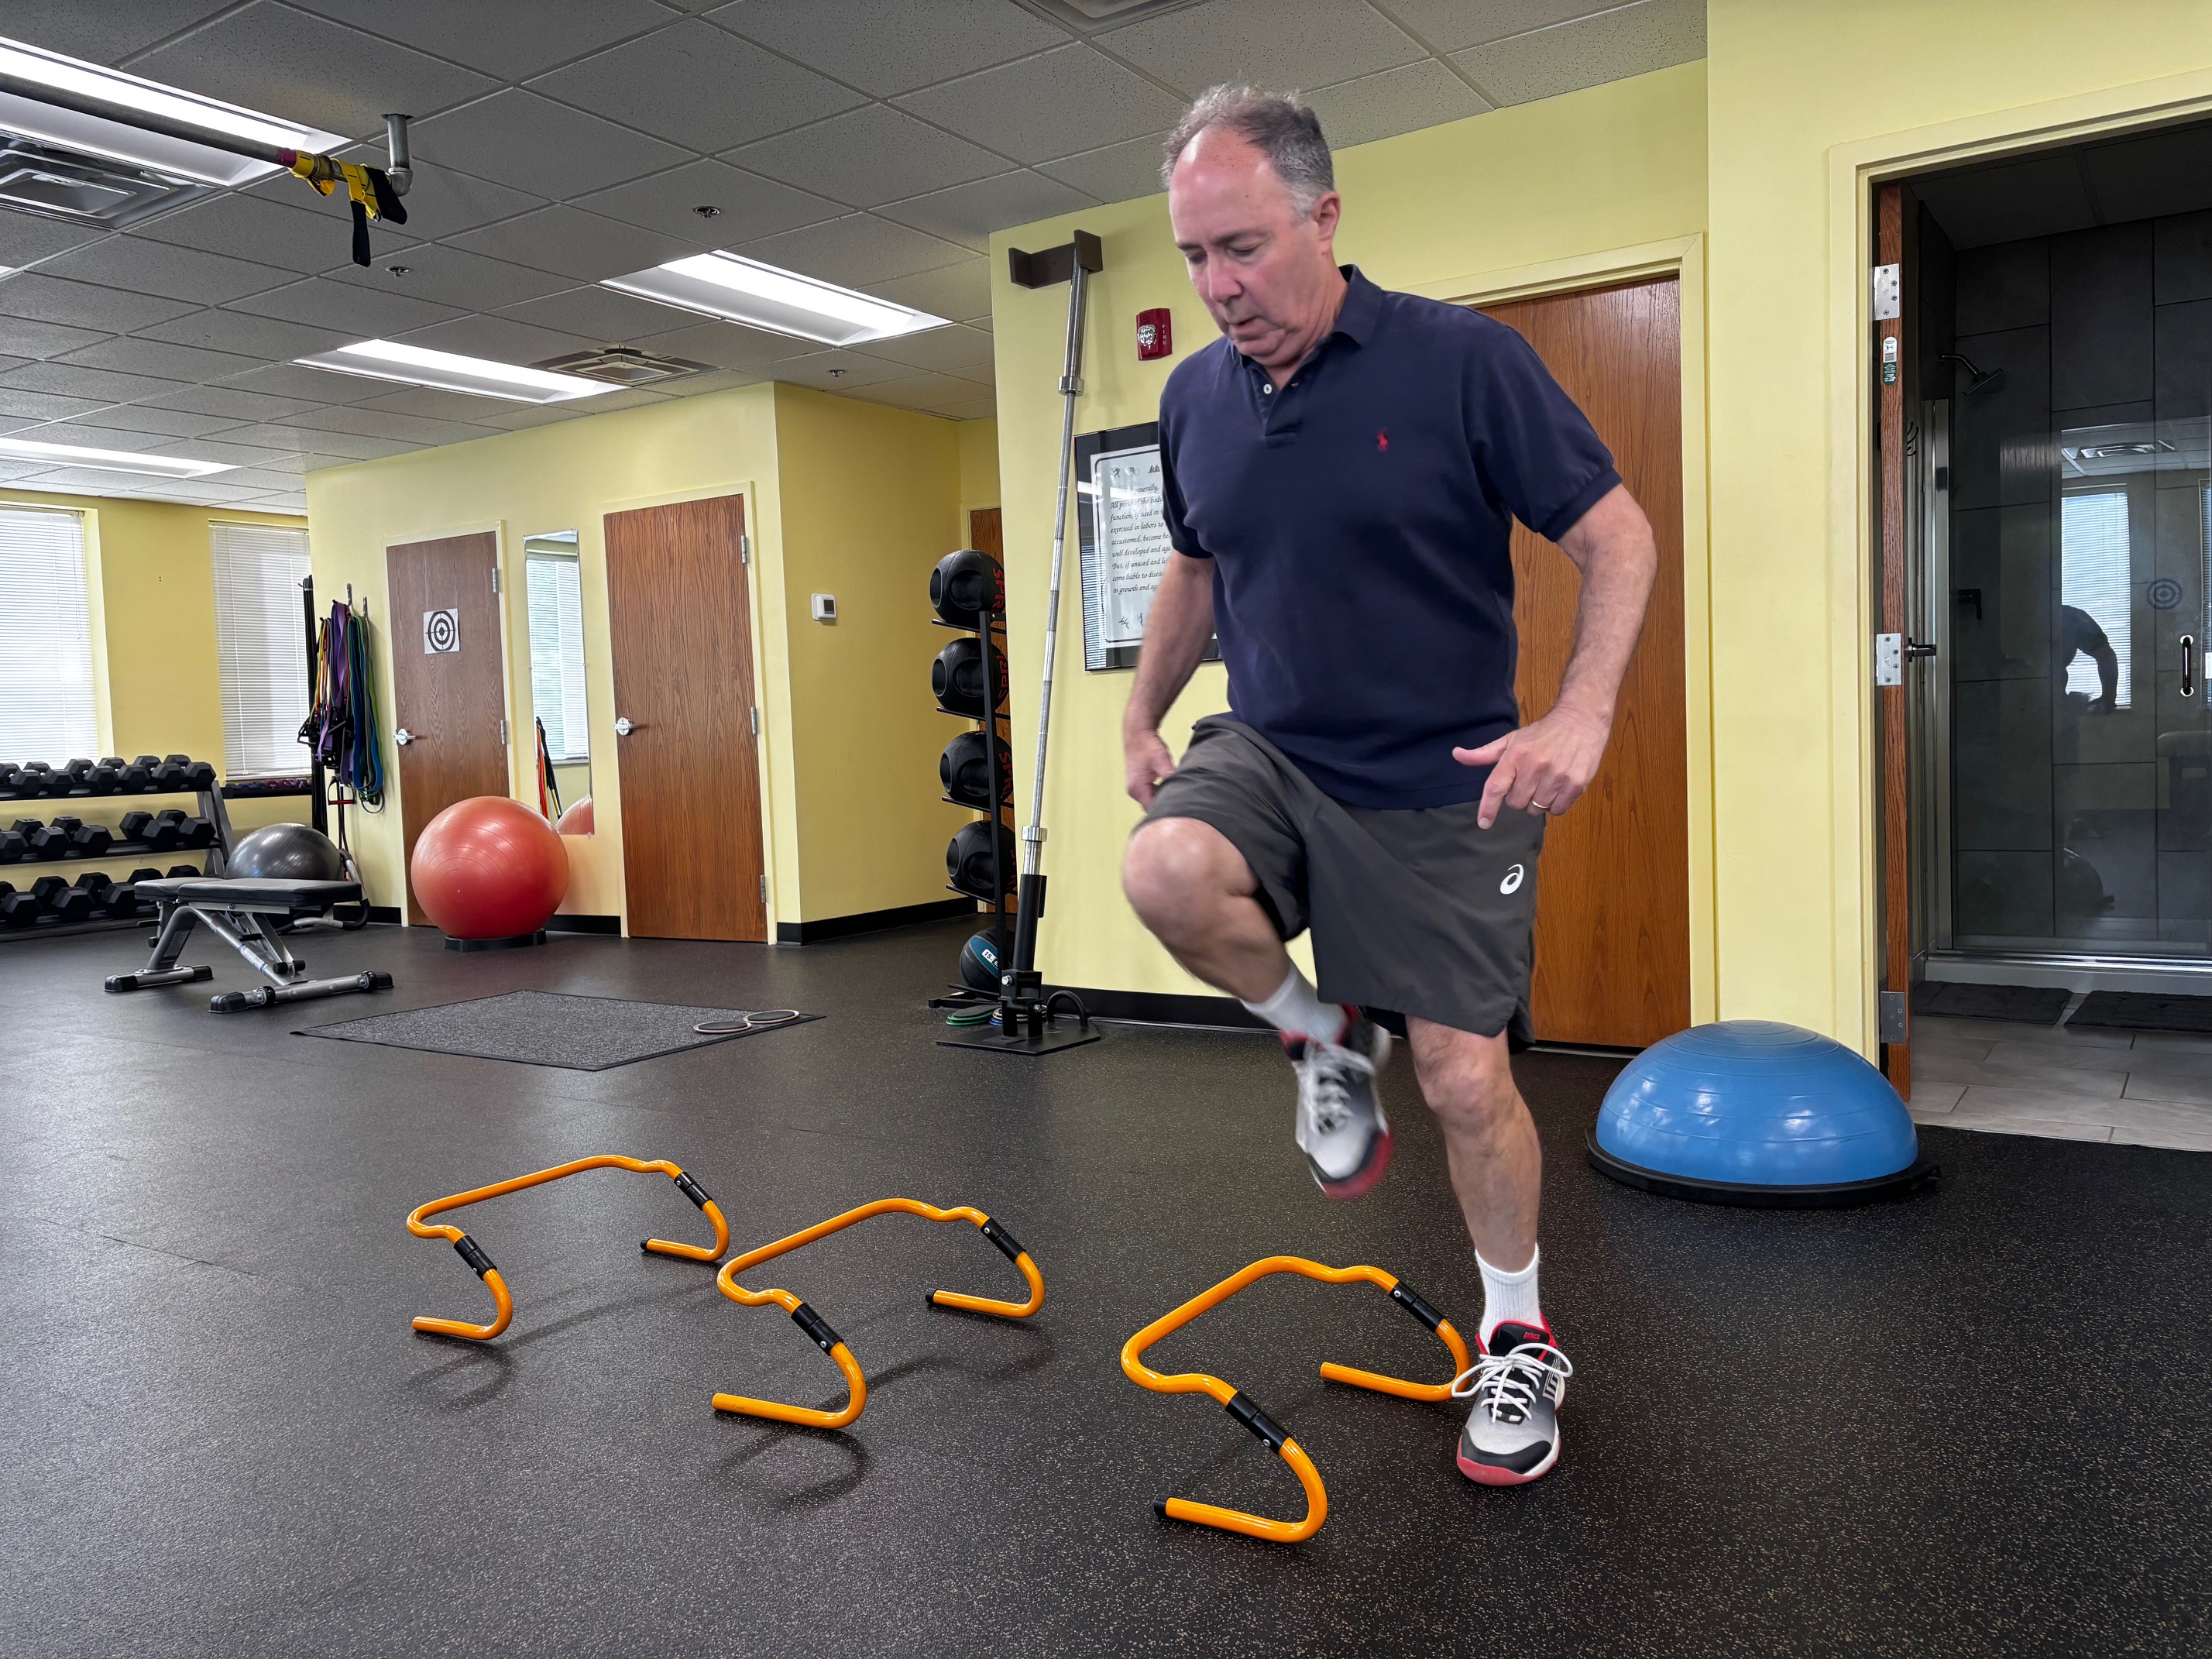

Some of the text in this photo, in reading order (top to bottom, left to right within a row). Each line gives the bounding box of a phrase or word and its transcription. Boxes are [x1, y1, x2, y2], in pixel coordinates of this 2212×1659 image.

[1111, 524, 1134, 534] exercised
[1141, 521, 1157, 530] labors
[1111, 534, 1142, 545] accustomed,
[1112, 549, 1124, 558] well
[1124, 546, 1150, 556] developed
[1125, 561, 1131, 570] if
[1131, 558, 1150, 568] unused
[1126, 571, 1141, 580] liable
[1118, 584, 1139, 595] growth
[984, 951, 993, 960] 15
